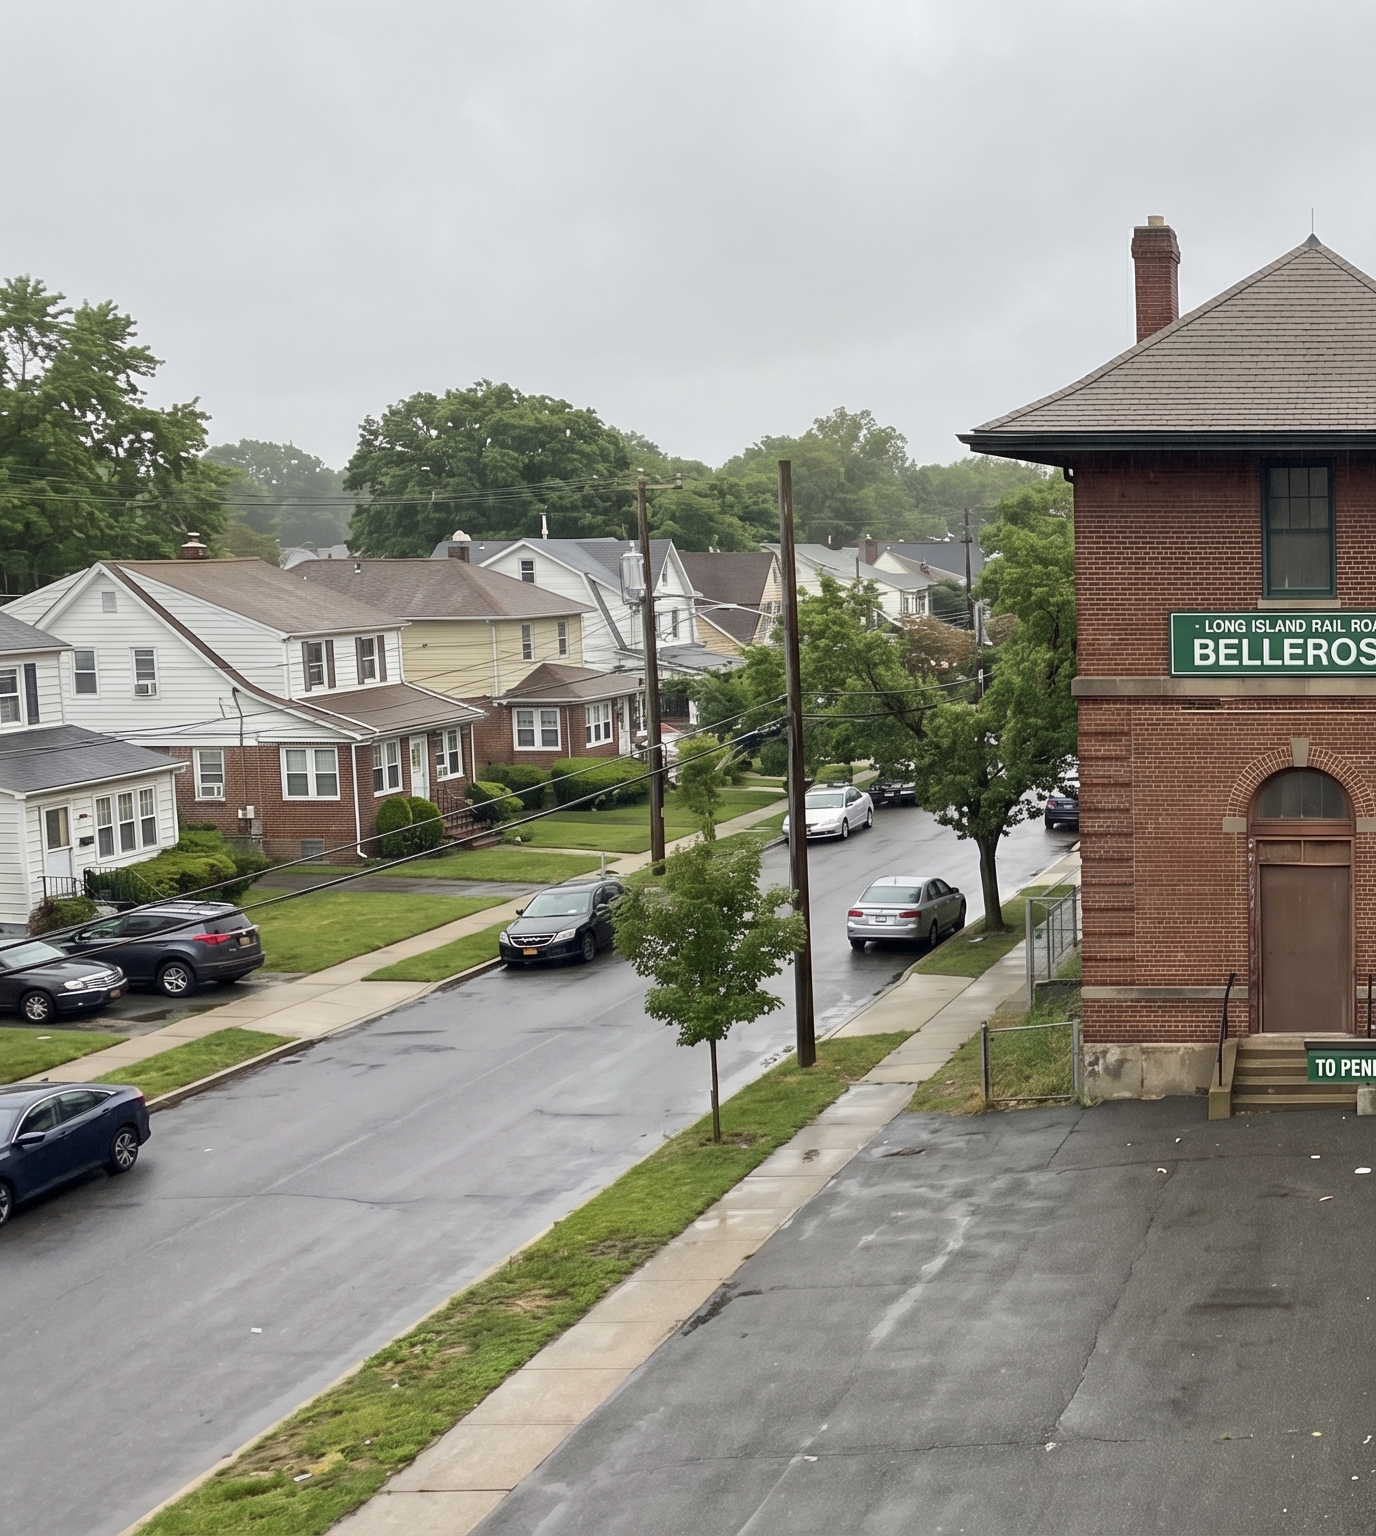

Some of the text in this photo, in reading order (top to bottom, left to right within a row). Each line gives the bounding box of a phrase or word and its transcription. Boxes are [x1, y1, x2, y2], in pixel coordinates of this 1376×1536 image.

[1205, 619, 1247, 633] LONG
[1251, 619, 1307, 633] ISLAND
[1311, 619, 1346, 633] RAIL
[1316, 1058, 1336, 1077] TO
